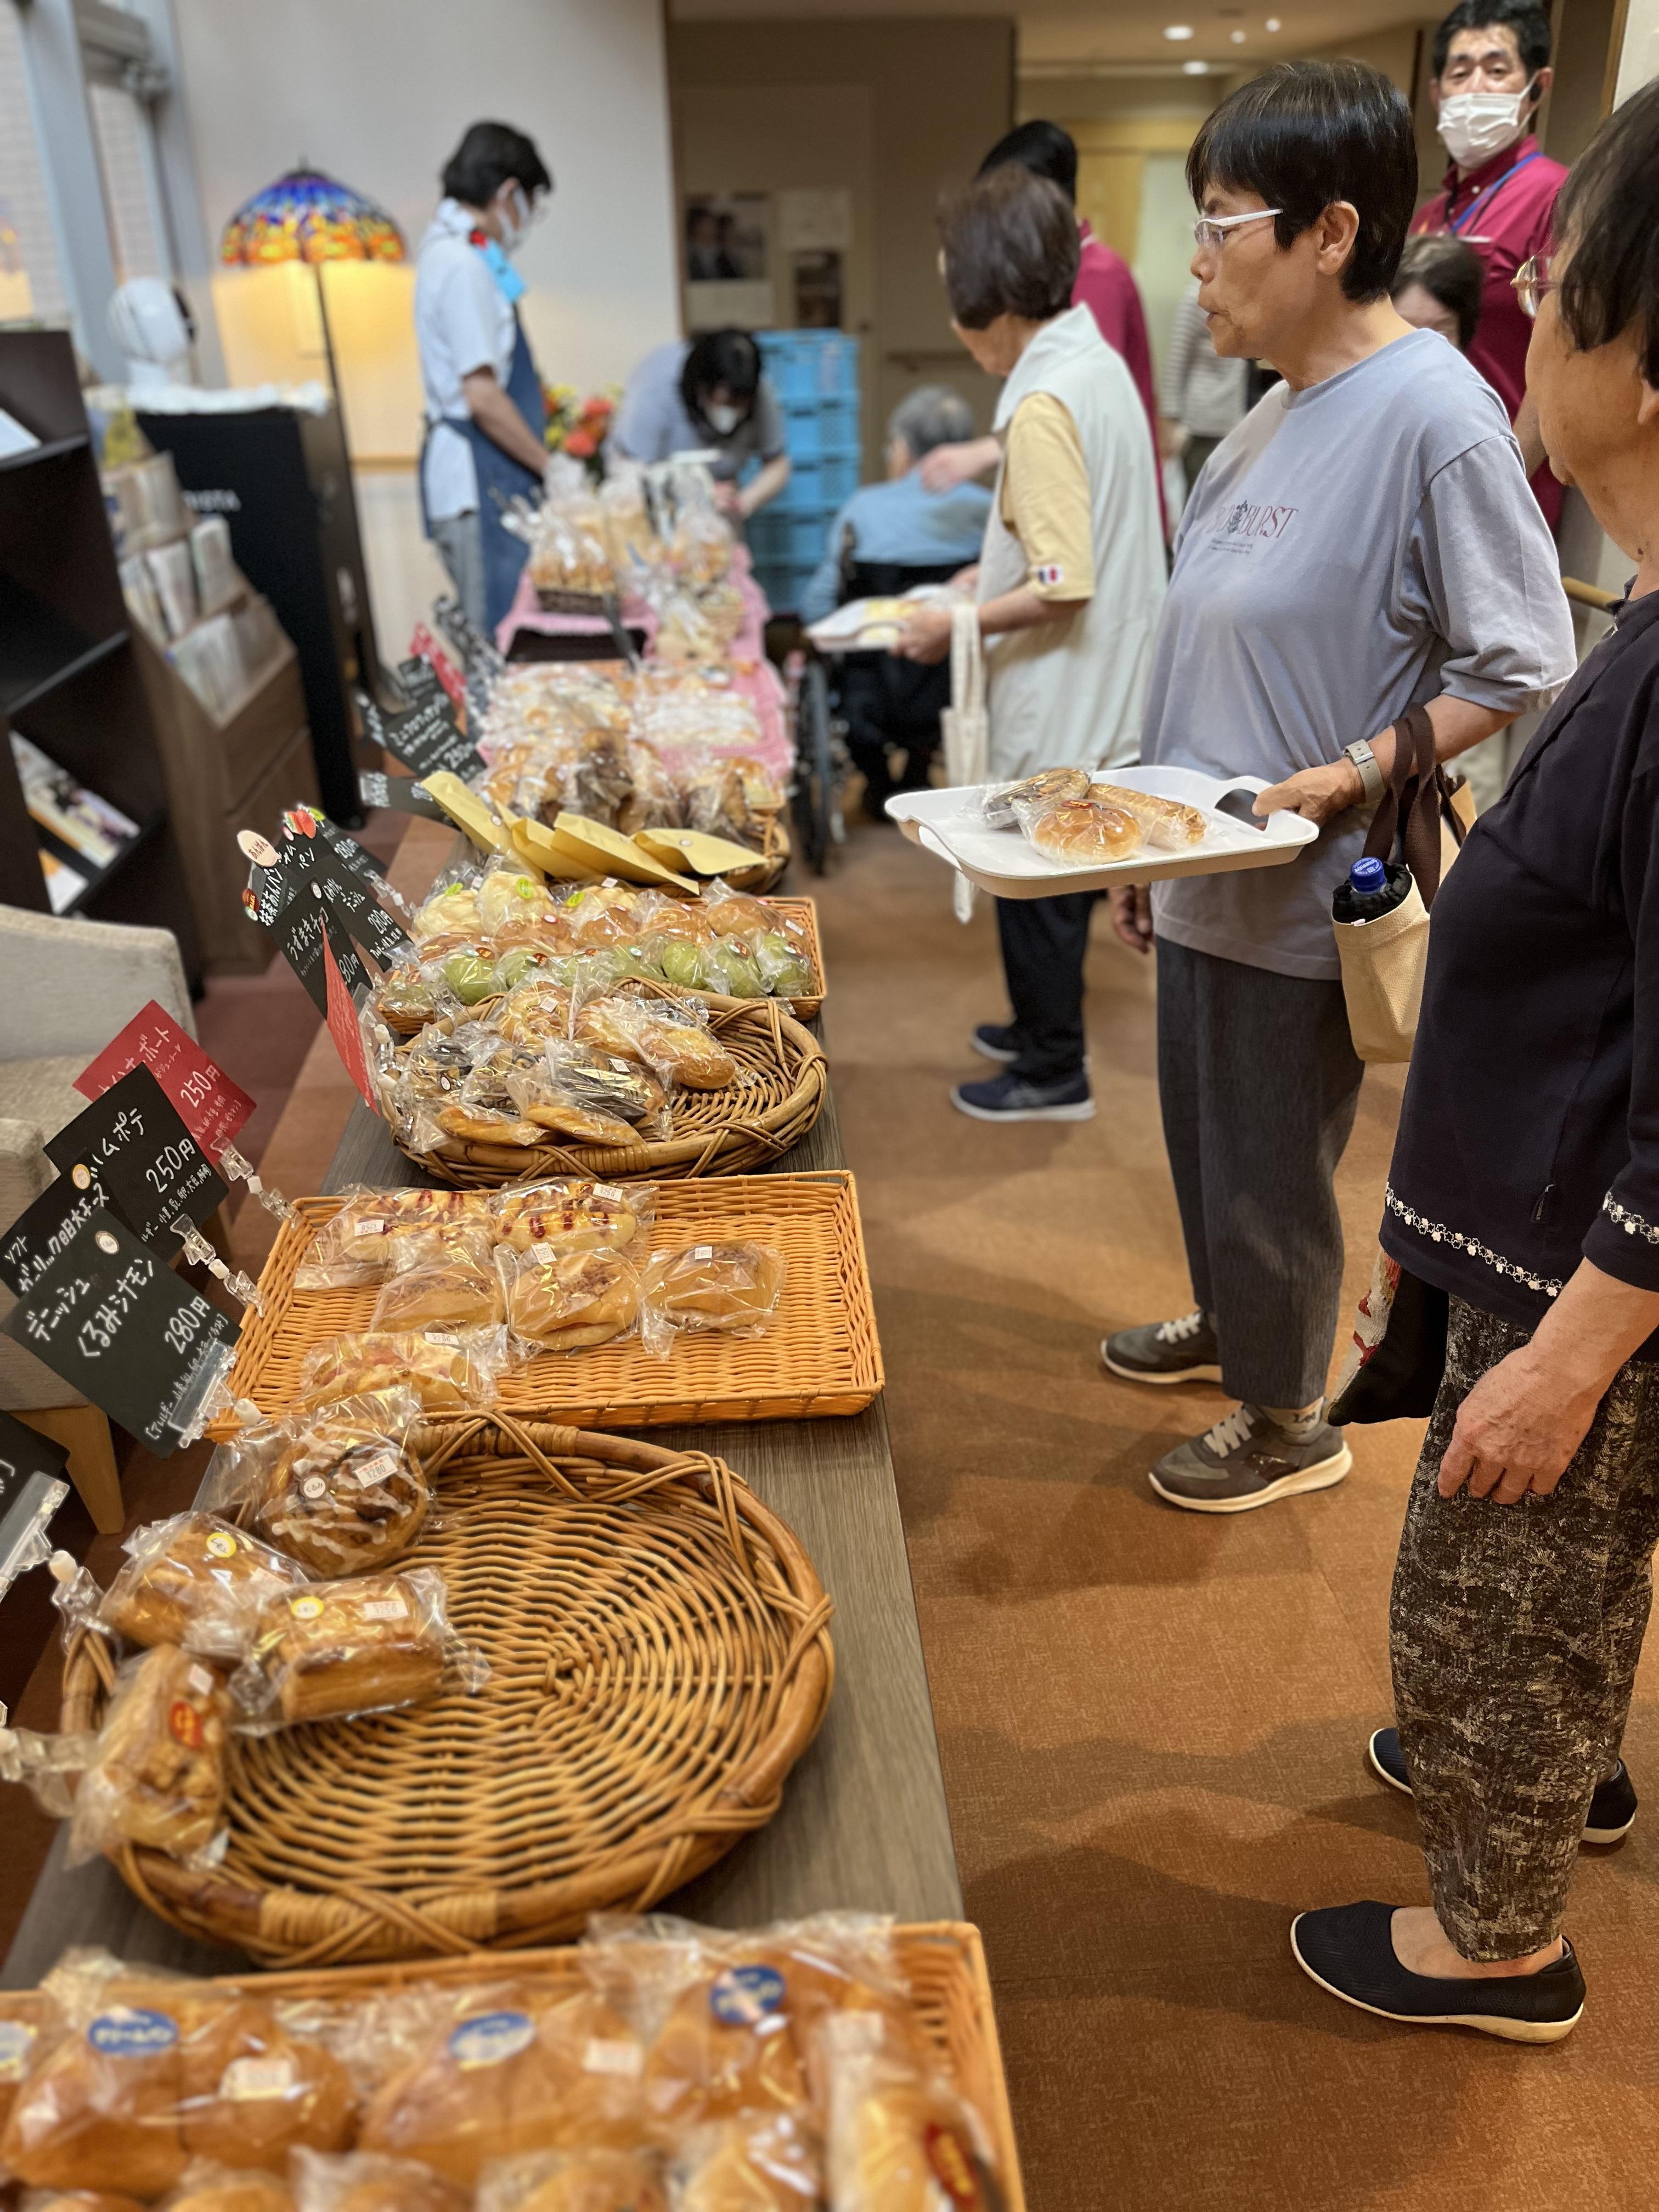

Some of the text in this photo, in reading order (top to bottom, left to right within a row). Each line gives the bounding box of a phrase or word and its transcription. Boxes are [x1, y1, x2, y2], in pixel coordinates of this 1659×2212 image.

[280, 845, 297, 865] ャム
[299, 847, 315, 869] パン
[334, 838, 359, 859] 280円
[368, 910, 394, 934] 280円
[337, 952, 360, 984] 80円
[180, 1064, 220, 1108] 250円
[146, 1138, 196, 1193] 250円
[4, 1237, 27, 1265] ソフト
[27, 1279, 90, 1341] デニッシュ
[78, 1259, 153, 1357] くるみシナモン
[165, 1296, 211, 1355] 280円
[1293, 1412, 1316, 1424] Lee
[366, 1464, 387, 1480] ¥280
[306, 1482, 323, 1493] くるみ
